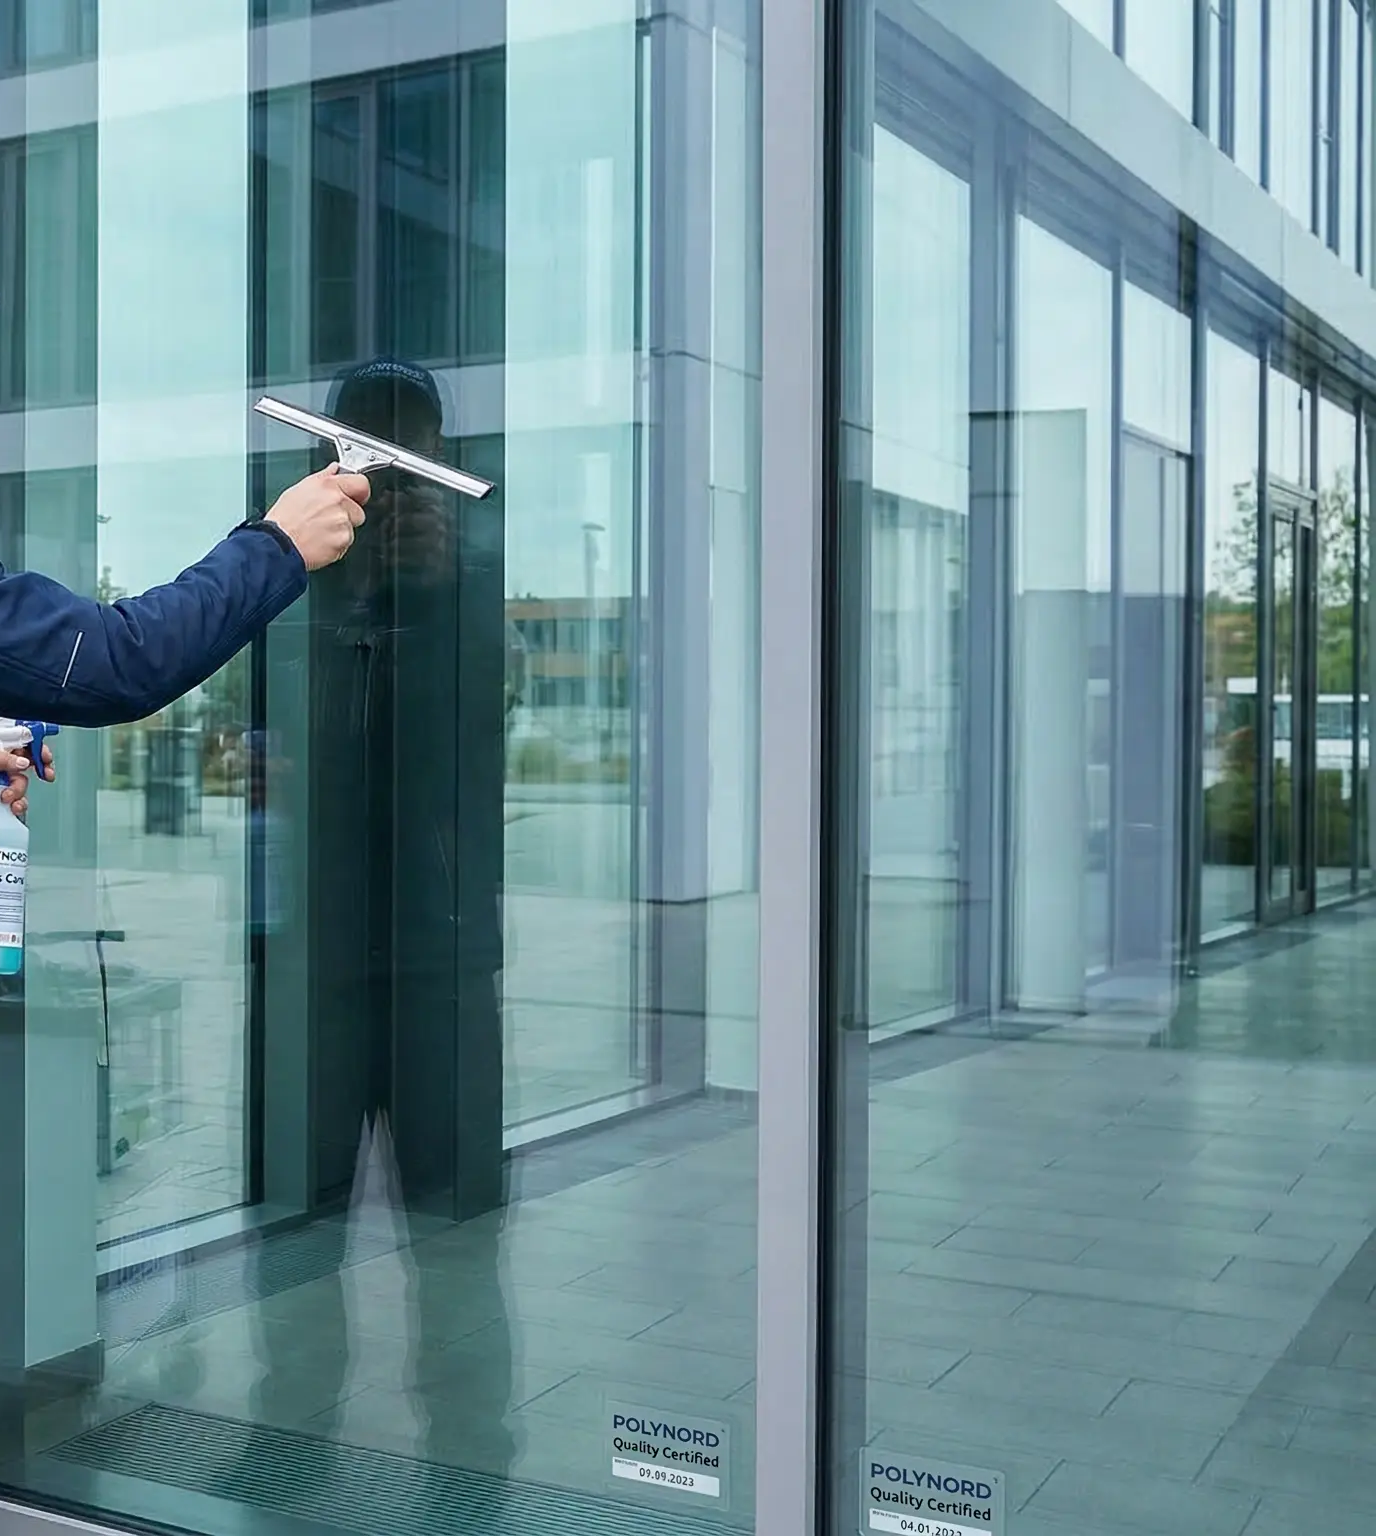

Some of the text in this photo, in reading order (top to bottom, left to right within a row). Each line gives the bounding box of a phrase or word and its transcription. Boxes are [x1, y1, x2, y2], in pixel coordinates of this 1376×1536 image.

[613, 1414, 719, 1447] POLYNORD
[613, 1437, 659, 1458] Quality
[662, 1447, 719, 1467] Certified
[639, 1467, 694, 1487] 09.09.2023
[870, 1463, 992, 1499] POLYNORD
[870, 1487, 991, 1521] Quality Certified
